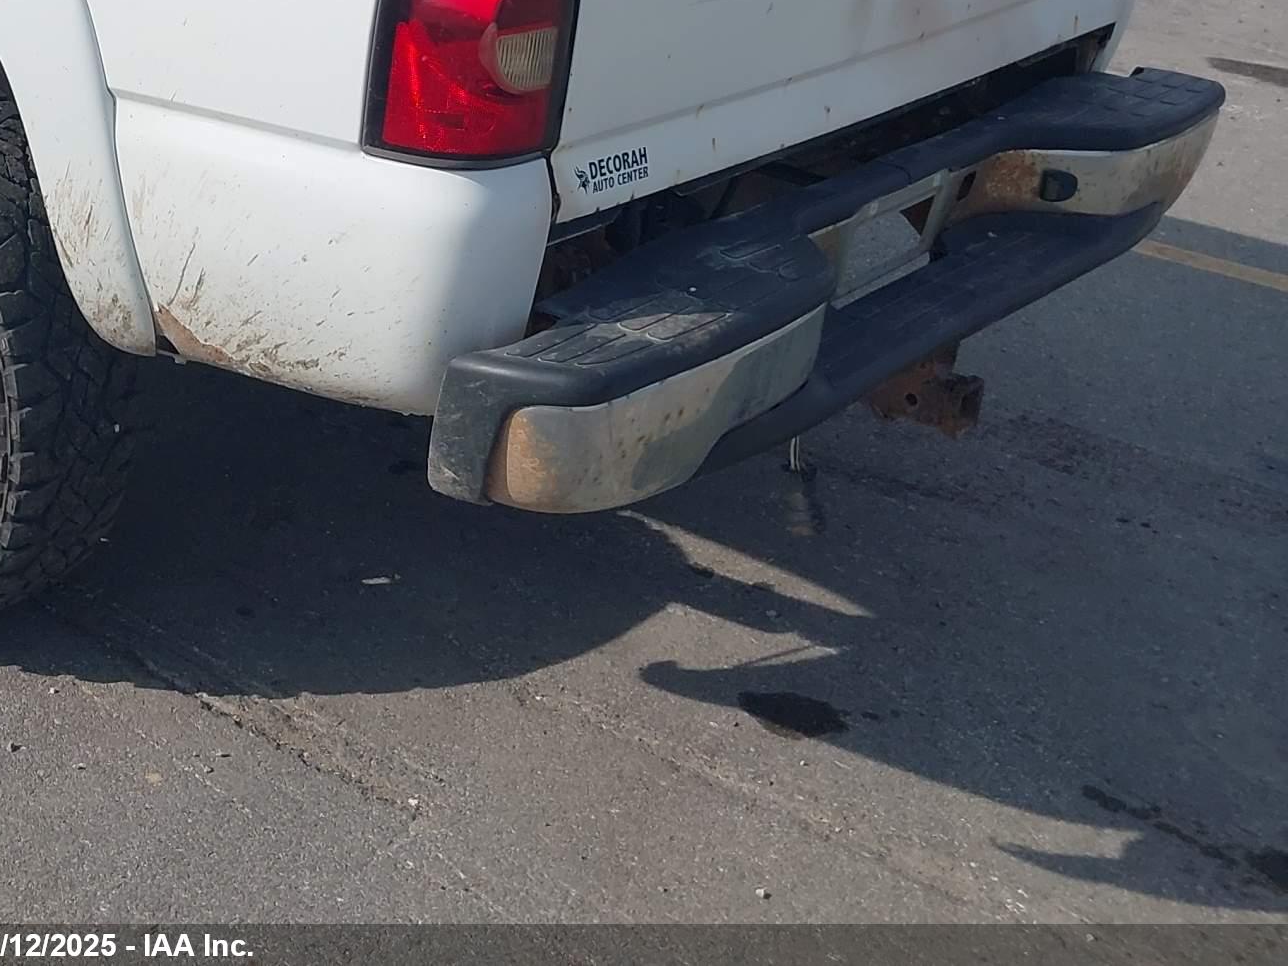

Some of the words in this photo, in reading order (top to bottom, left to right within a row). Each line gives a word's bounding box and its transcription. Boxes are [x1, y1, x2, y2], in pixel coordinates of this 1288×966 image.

[588, 147, 648, 181] DECORAH
[593, 177, 615, 193] AUTO
[617, 166, 649, 186] CENTER
